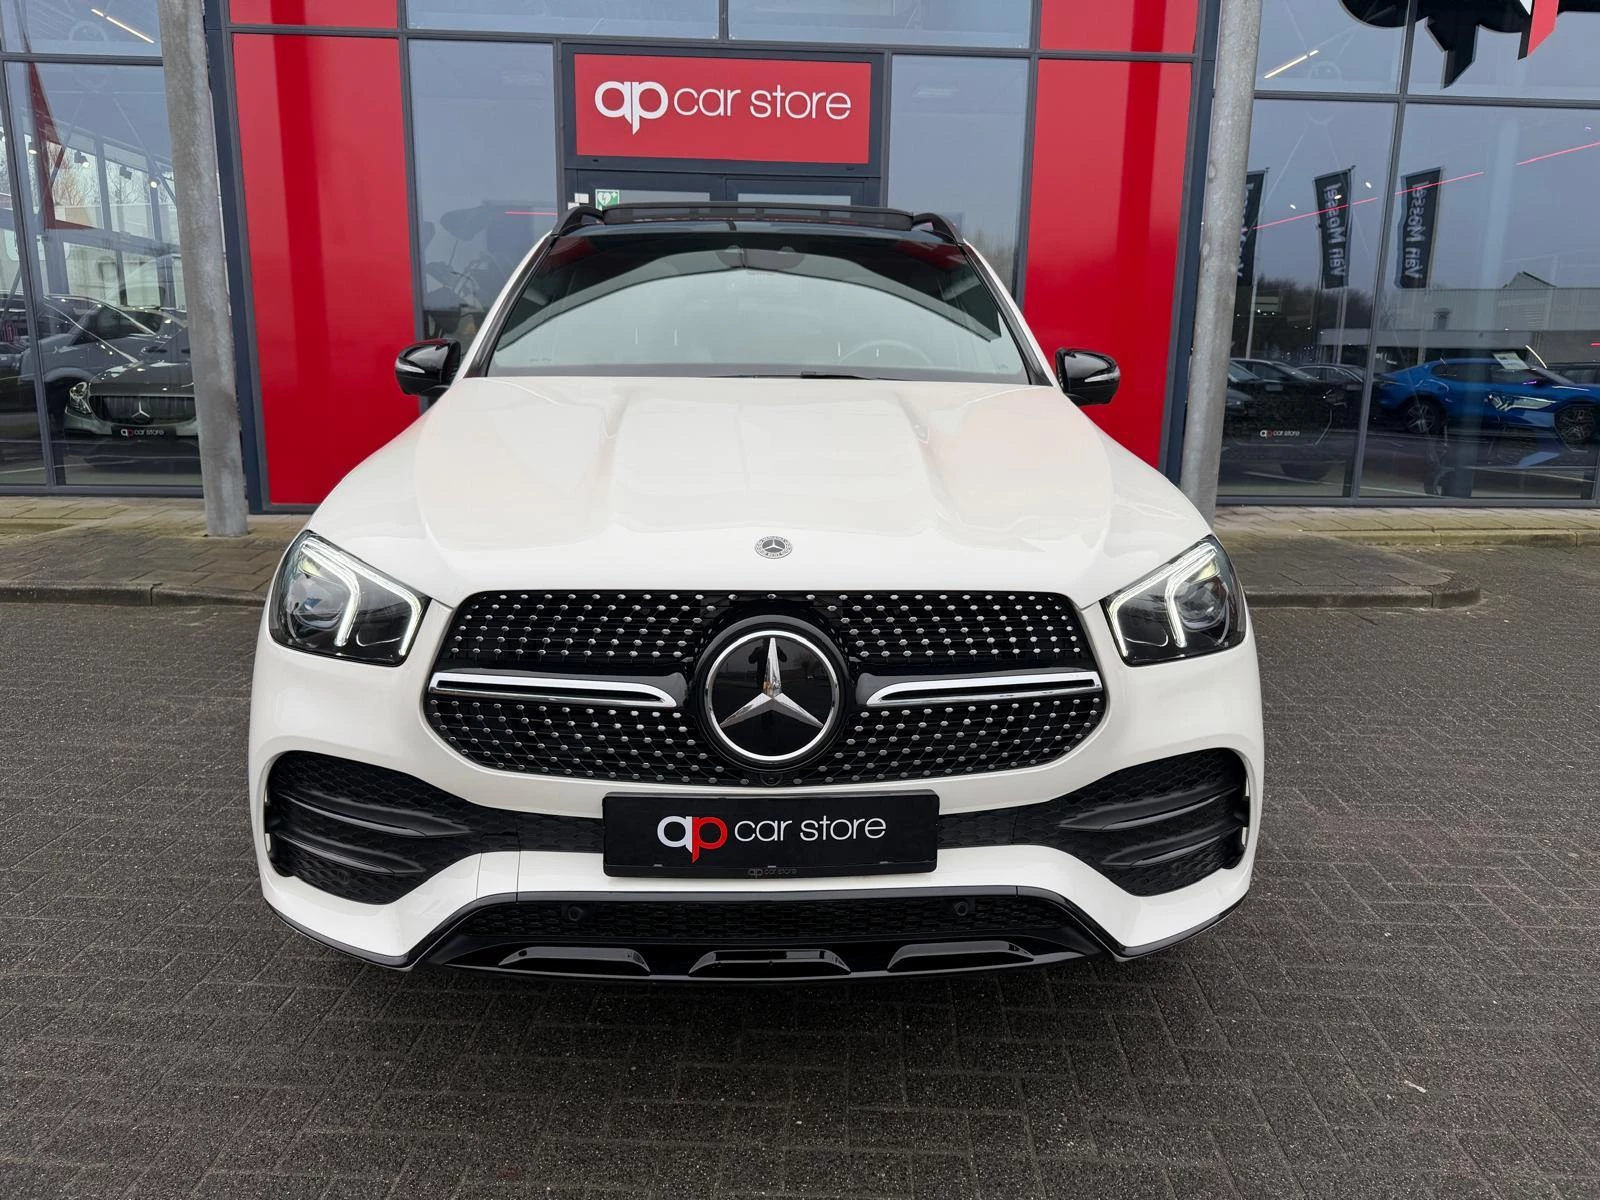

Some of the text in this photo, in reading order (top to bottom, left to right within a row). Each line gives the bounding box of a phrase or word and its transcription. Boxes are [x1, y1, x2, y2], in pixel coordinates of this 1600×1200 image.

[594, 81, 852, 136] ap car store
[656, 815, 887, 864] ap car store
